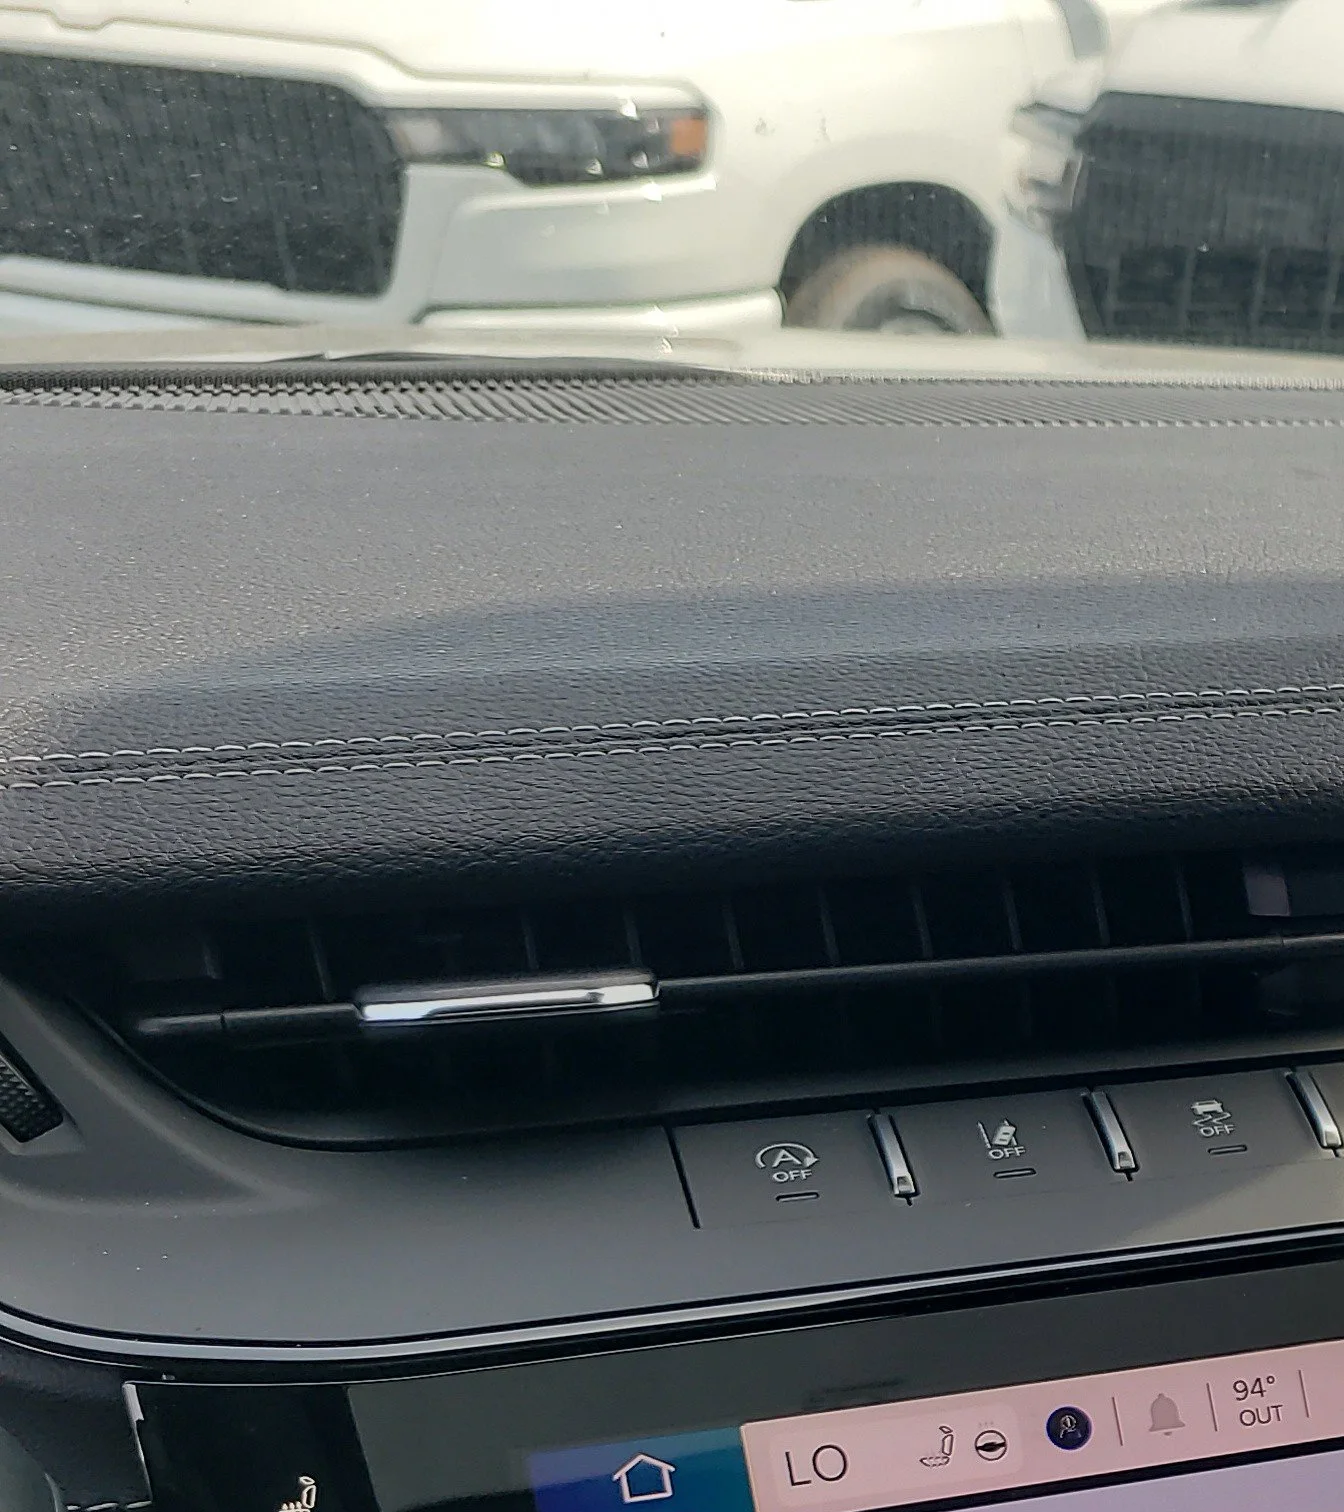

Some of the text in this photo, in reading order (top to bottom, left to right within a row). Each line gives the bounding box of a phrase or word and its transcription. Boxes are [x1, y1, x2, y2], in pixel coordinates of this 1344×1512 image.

[1199, 1122, 1236, 1138] OFF
[987, 1144, 1026, 1161] OFF
[771, 1166, 814, 1184] OFF
[1232, 1375, 1277, 1402] 94°
[1239, 1404, 1284, 1428] OUT
[785, 1443, 849, 1488] LO
